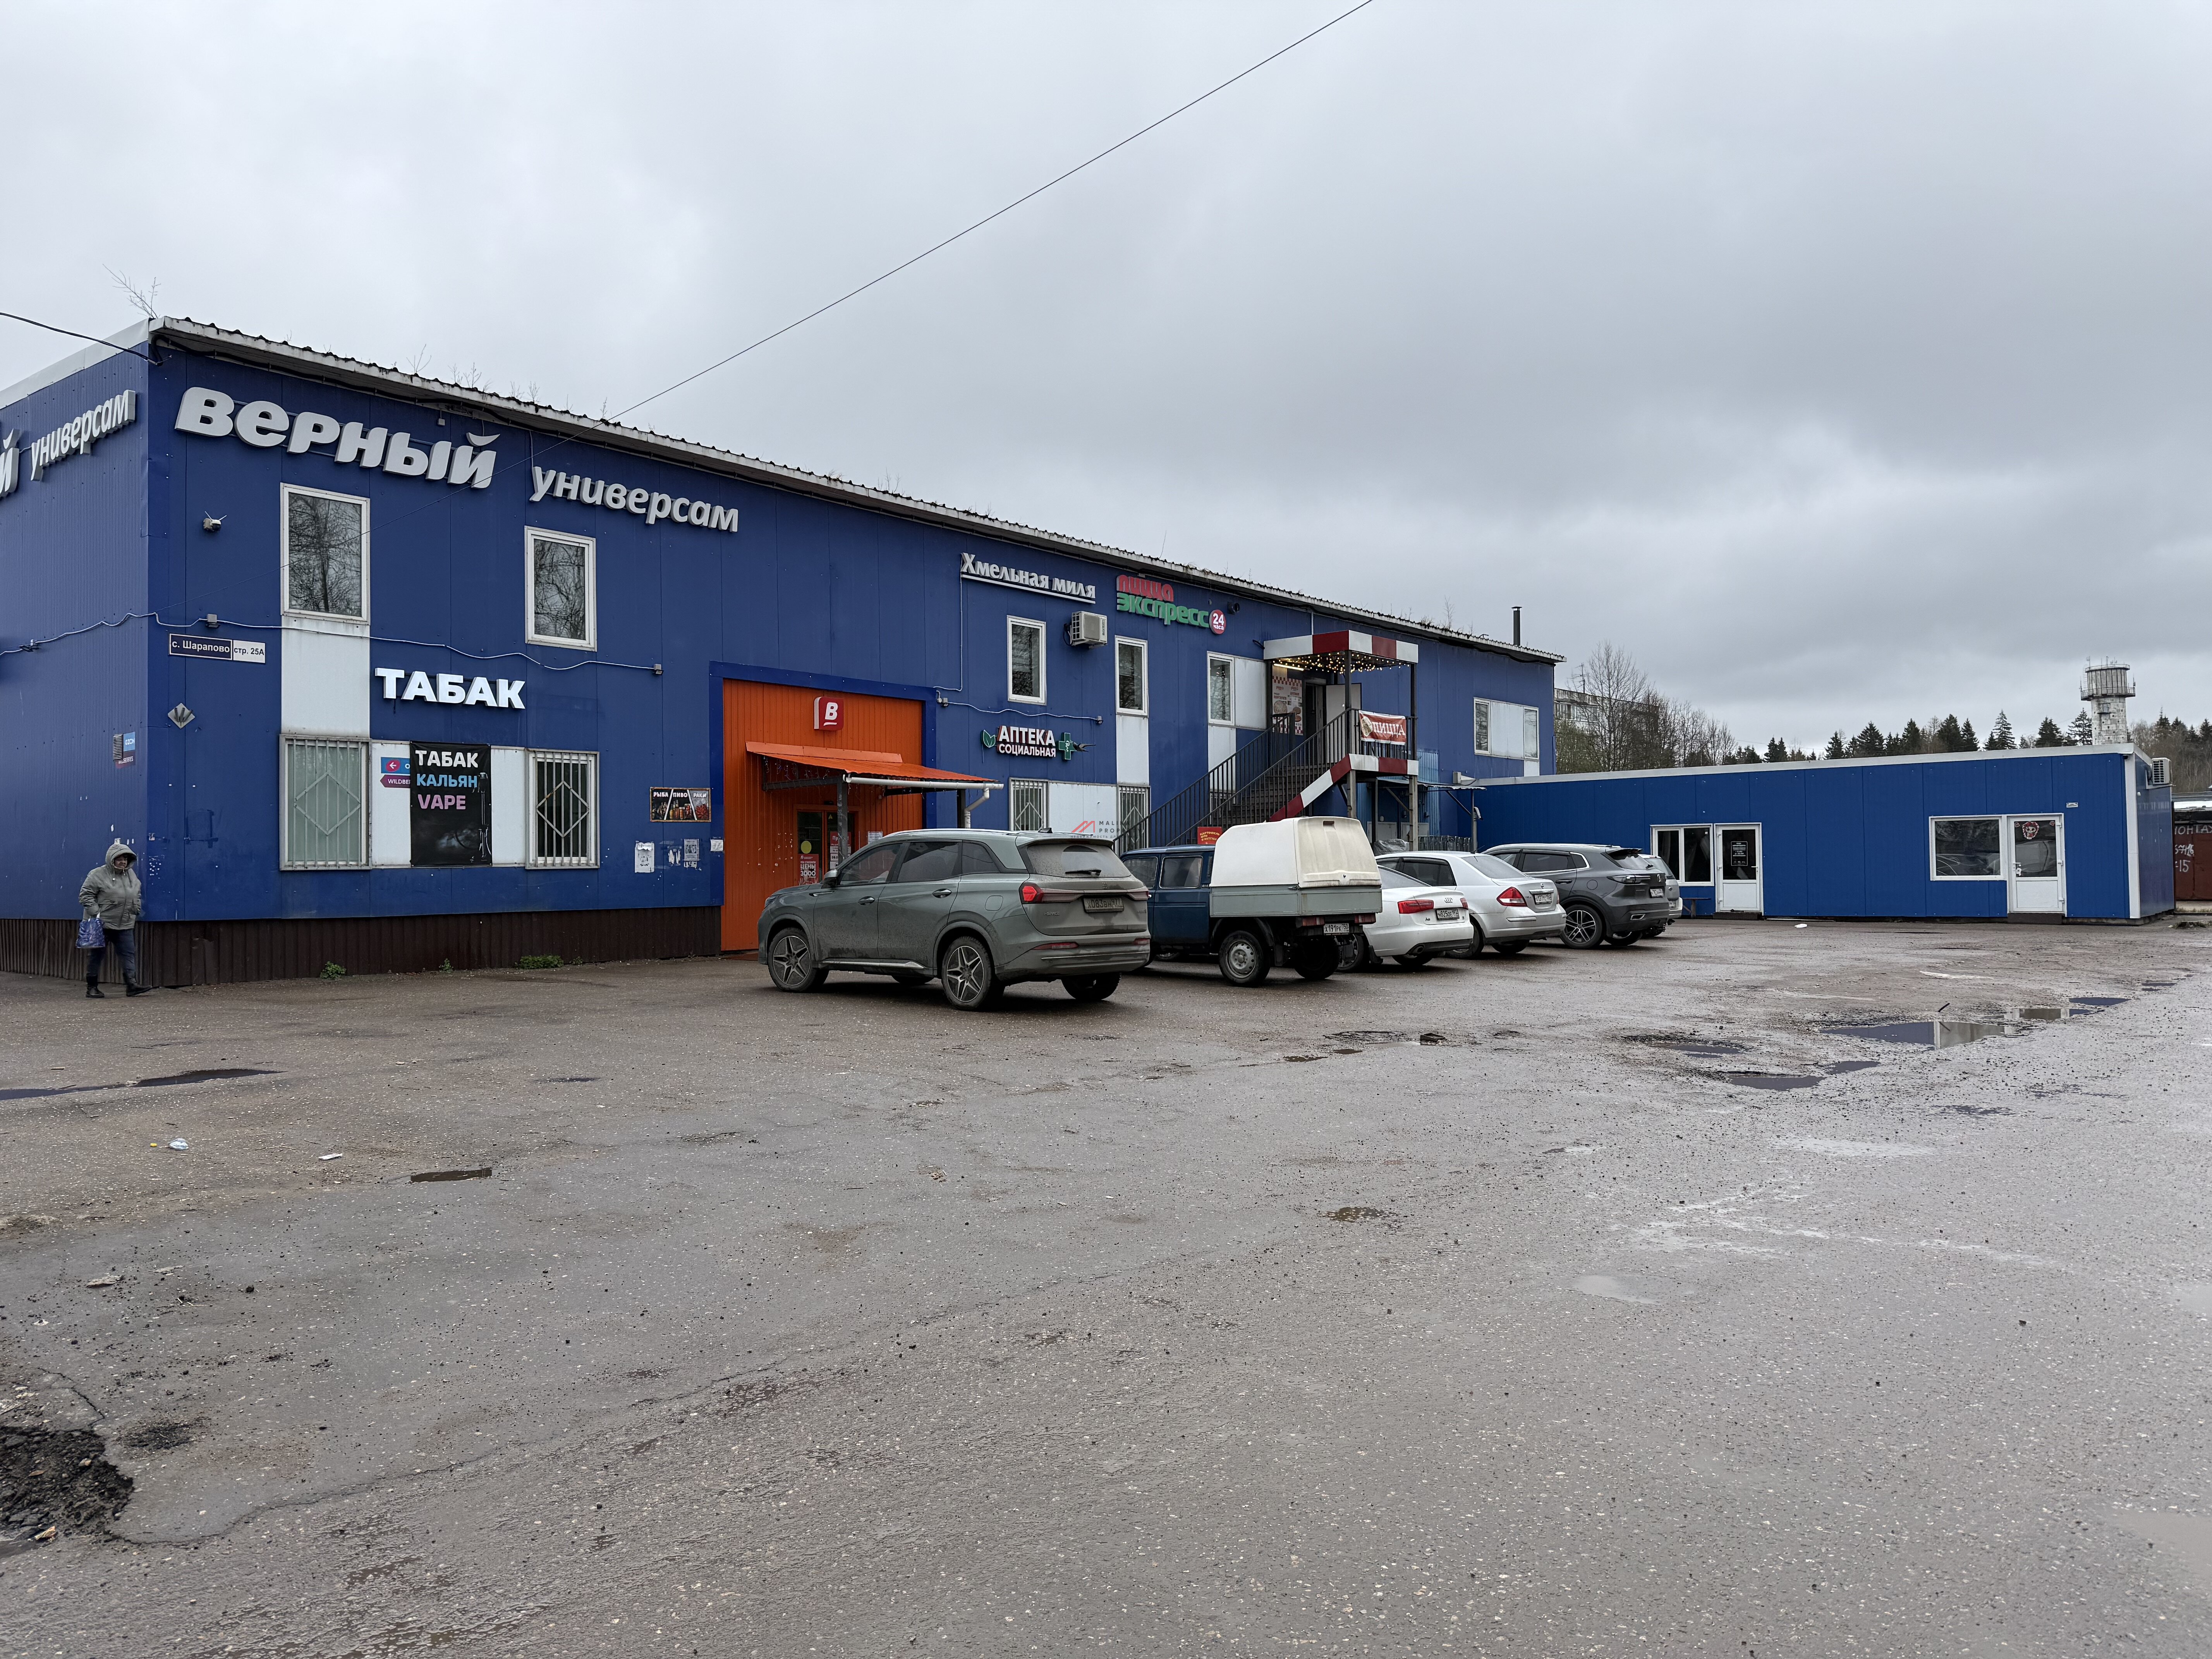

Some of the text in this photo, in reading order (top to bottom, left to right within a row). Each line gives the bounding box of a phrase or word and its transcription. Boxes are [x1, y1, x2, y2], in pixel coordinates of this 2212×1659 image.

[31, 390, 136, 481] универсам
[174, 386, 501, 489] Верный
[529, 466, 738, 532] универсам
[961, 552, 1096, 599] Хмельная миля
[1117, 592, 1209, 625] экспресс
[1213, 613, 1224, 625] 24
[182, 640, 230, 652] Шарапово
[234, 647, 248, 655] стр.
[375, 668, 526, 709] ТАБАК
[999, 725, 1056, 746] АПТЕКА
[1372, 721, 1406, 738] ПИЦЦА
[415, 750, 478, 768] ТАБАК
[999, 744, 1056, 757] СОЦИАЛЬНАЯ
[417, 773, 477, 788] КАЛЬЯН
[417, 794, 466, 810] VAPE
